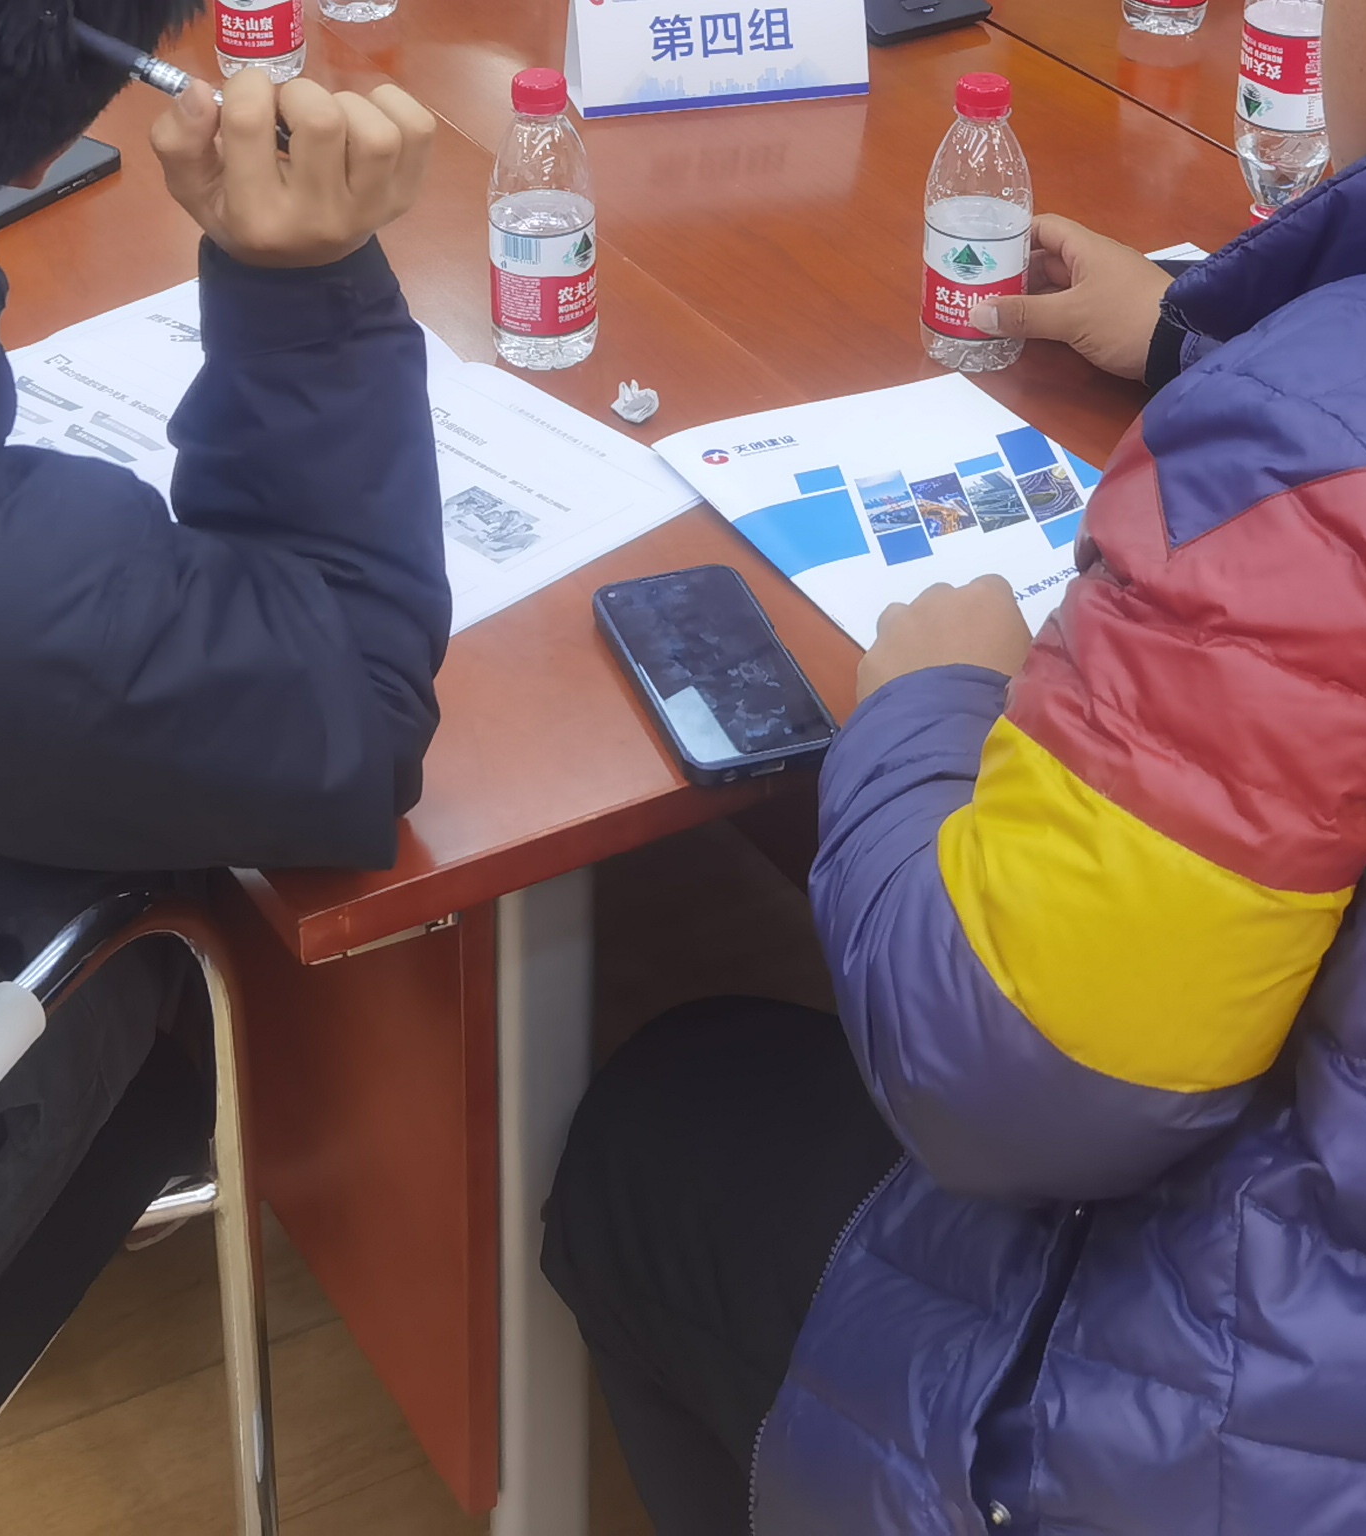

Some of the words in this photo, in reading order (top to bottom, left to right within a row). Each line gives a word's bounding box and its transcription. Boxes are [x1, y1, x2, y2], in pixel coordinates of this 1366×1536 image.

[221, 13, 274, 31] 农夫山泉
[649, 7, 794, 62] 第四组
